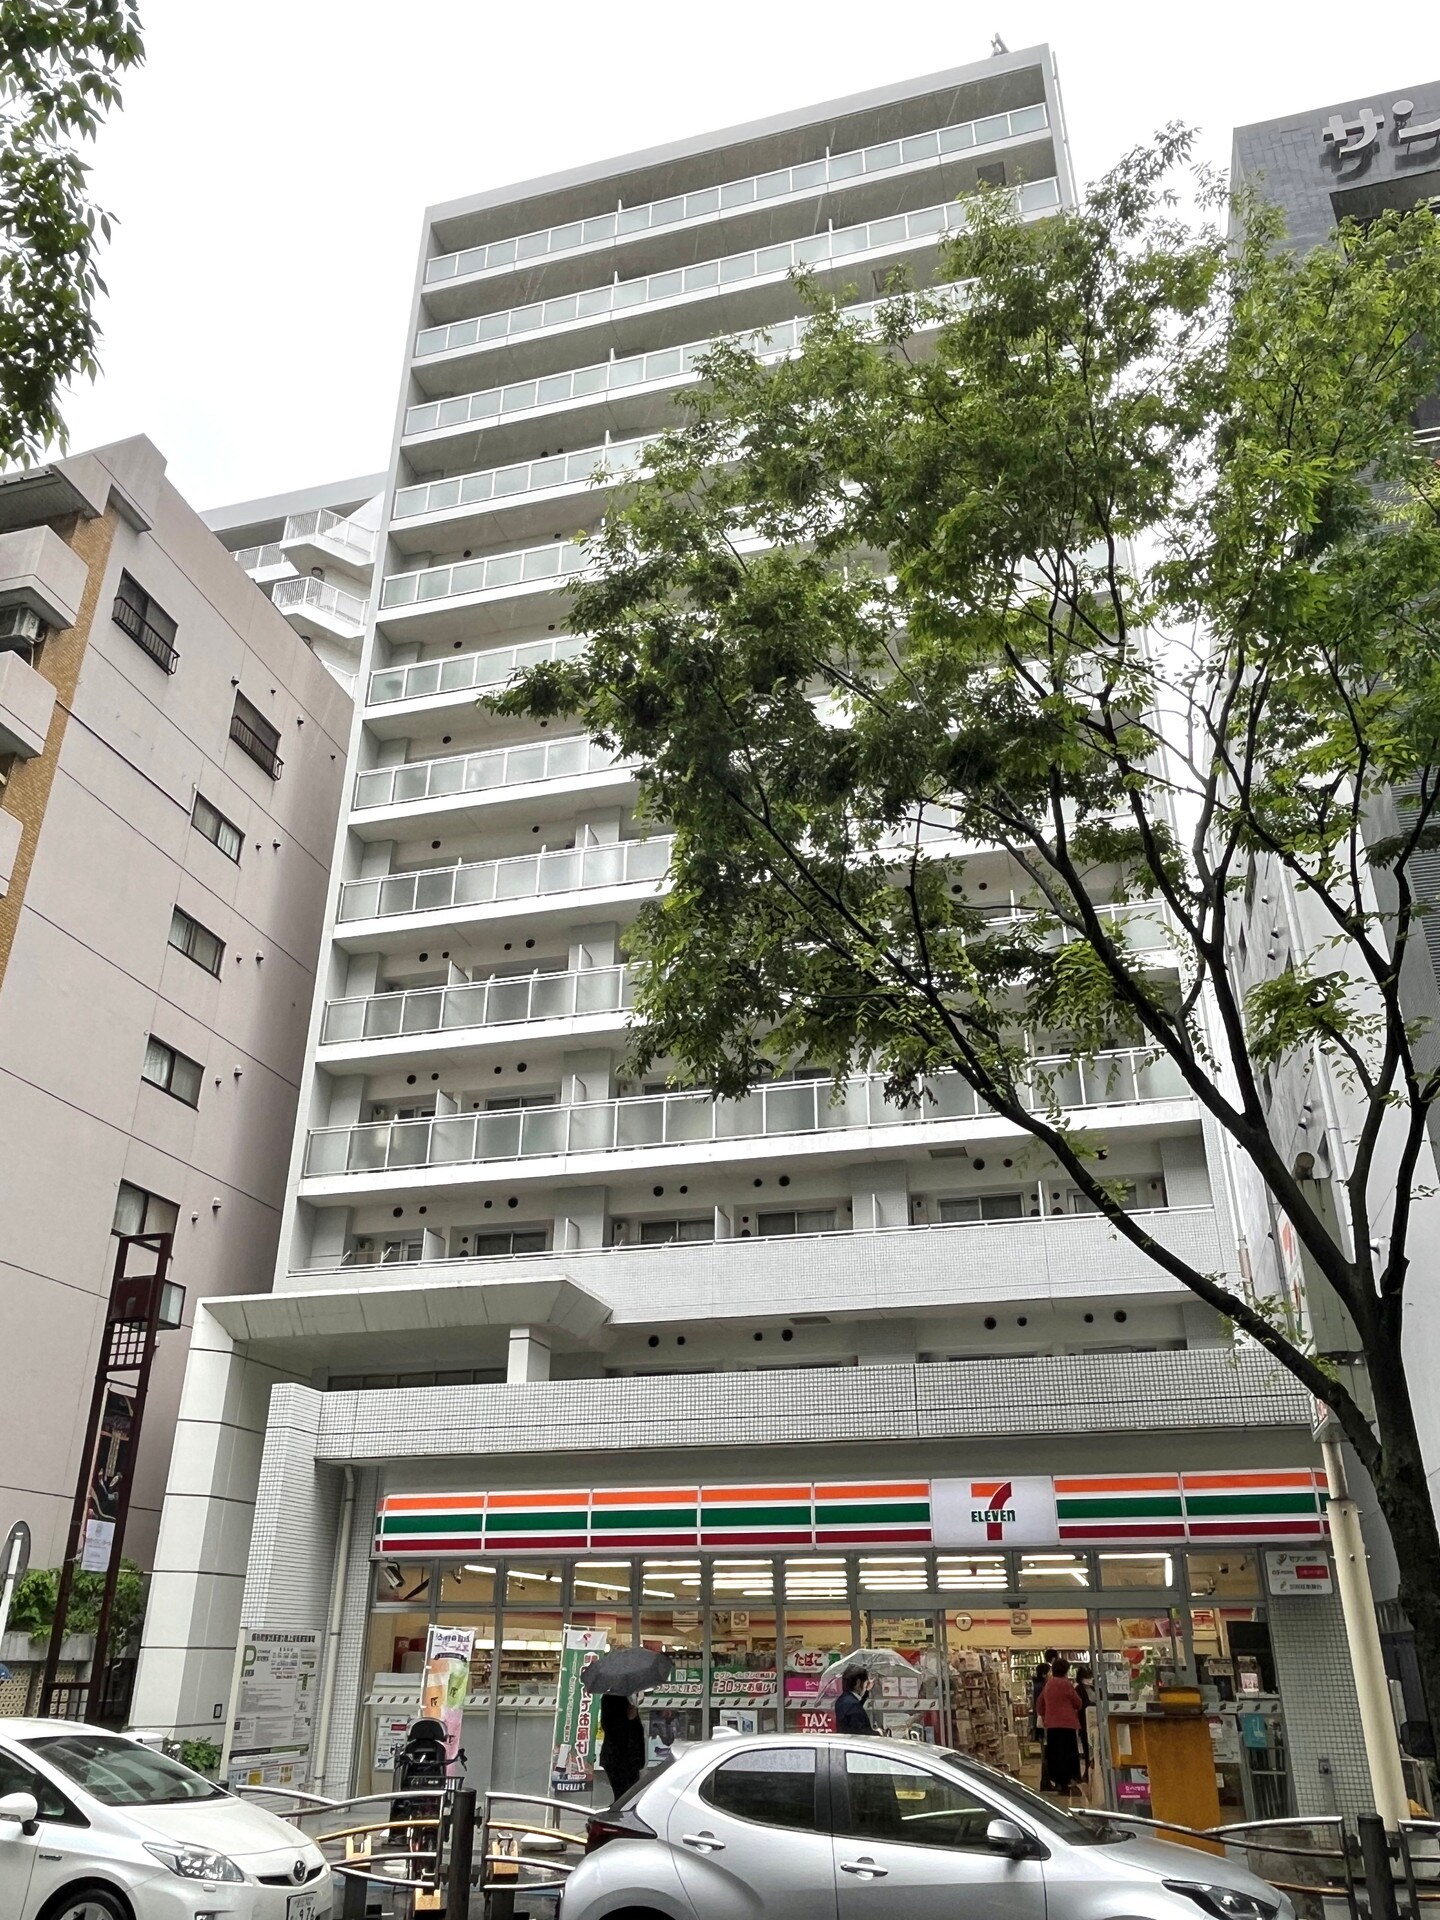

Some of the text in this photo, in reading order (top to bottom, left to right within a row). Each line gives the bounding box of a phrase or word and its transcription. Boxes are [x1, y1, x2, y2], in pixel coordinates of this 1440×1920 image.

[971, 1481, 1012, 1541] 7
[241, 1645, 257, 1677] P
[794, 1652, 824, 1667] たばこ
